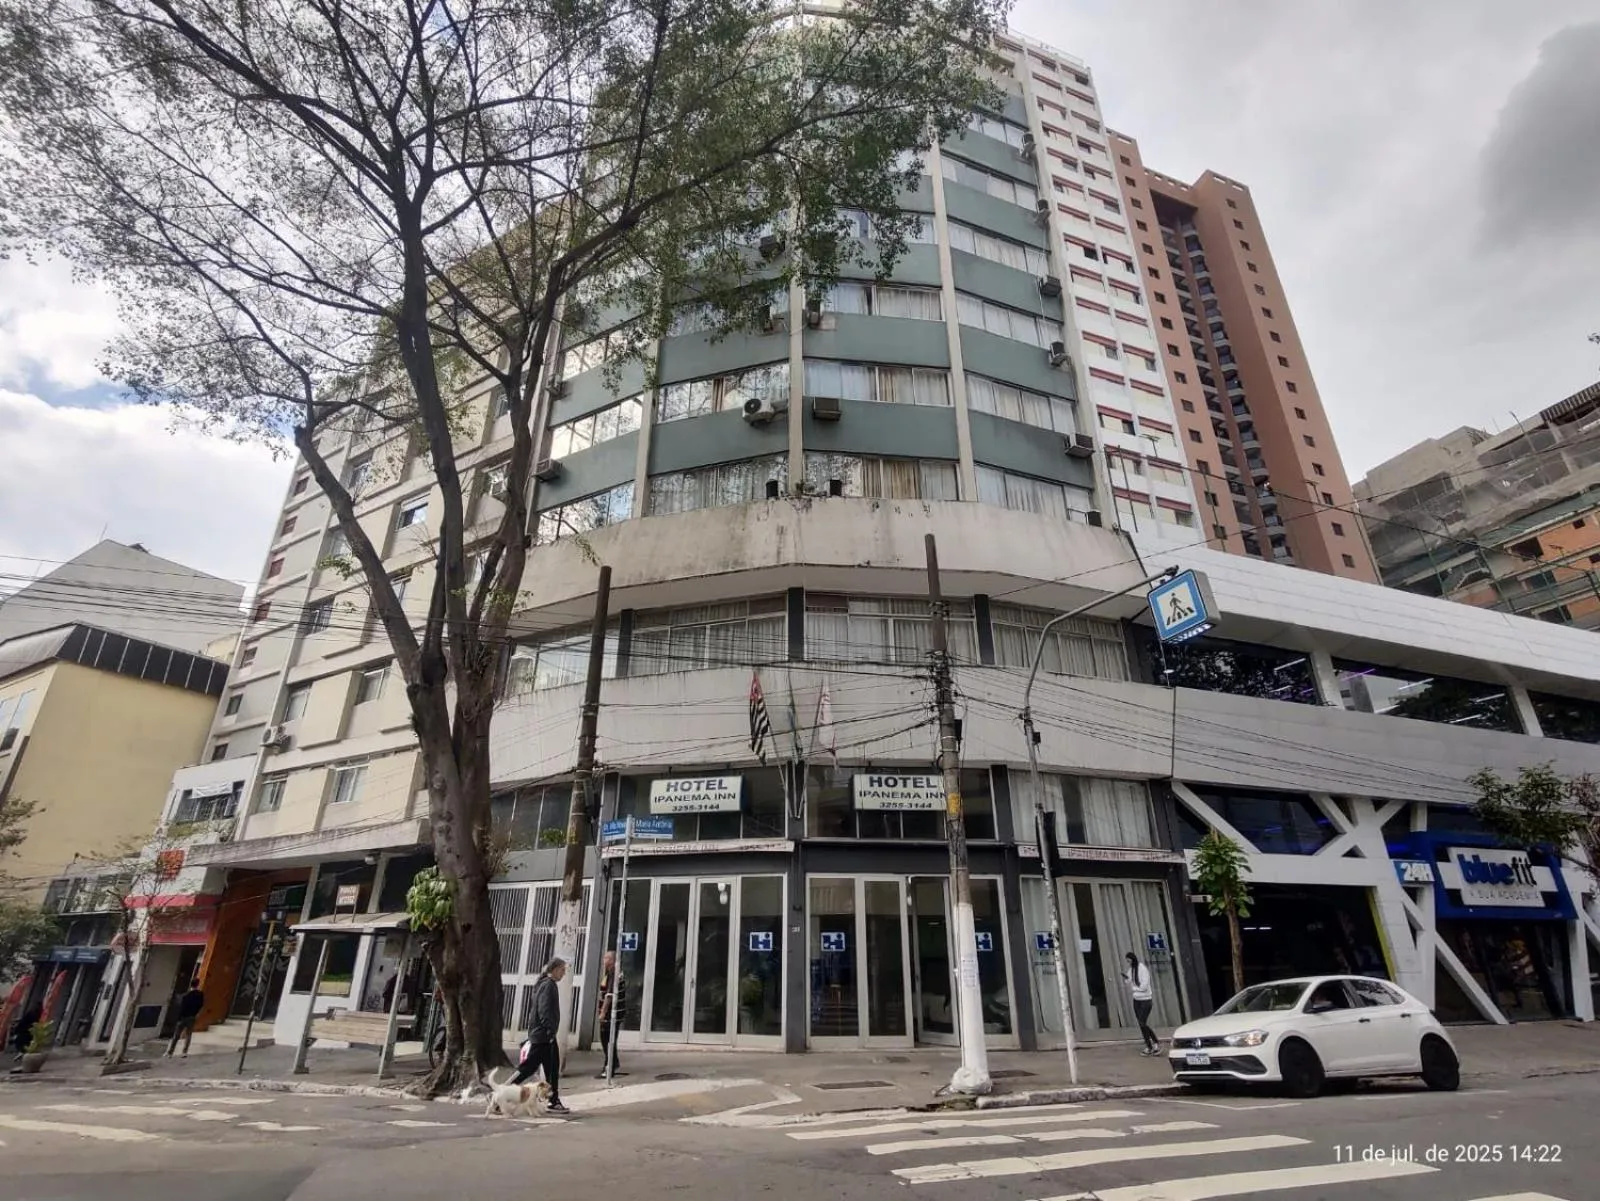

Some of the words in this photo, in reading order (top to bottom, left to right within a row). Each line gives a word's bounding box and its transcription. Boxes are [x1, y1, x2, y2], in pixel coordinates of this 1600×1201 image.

[666, 779, 728, 793] HOTEL
[869, 776, 937, 788] HOTEL
[654, 795, 711, 803] IPANEMA
[859, 791, 921, 799] IPANEMA
